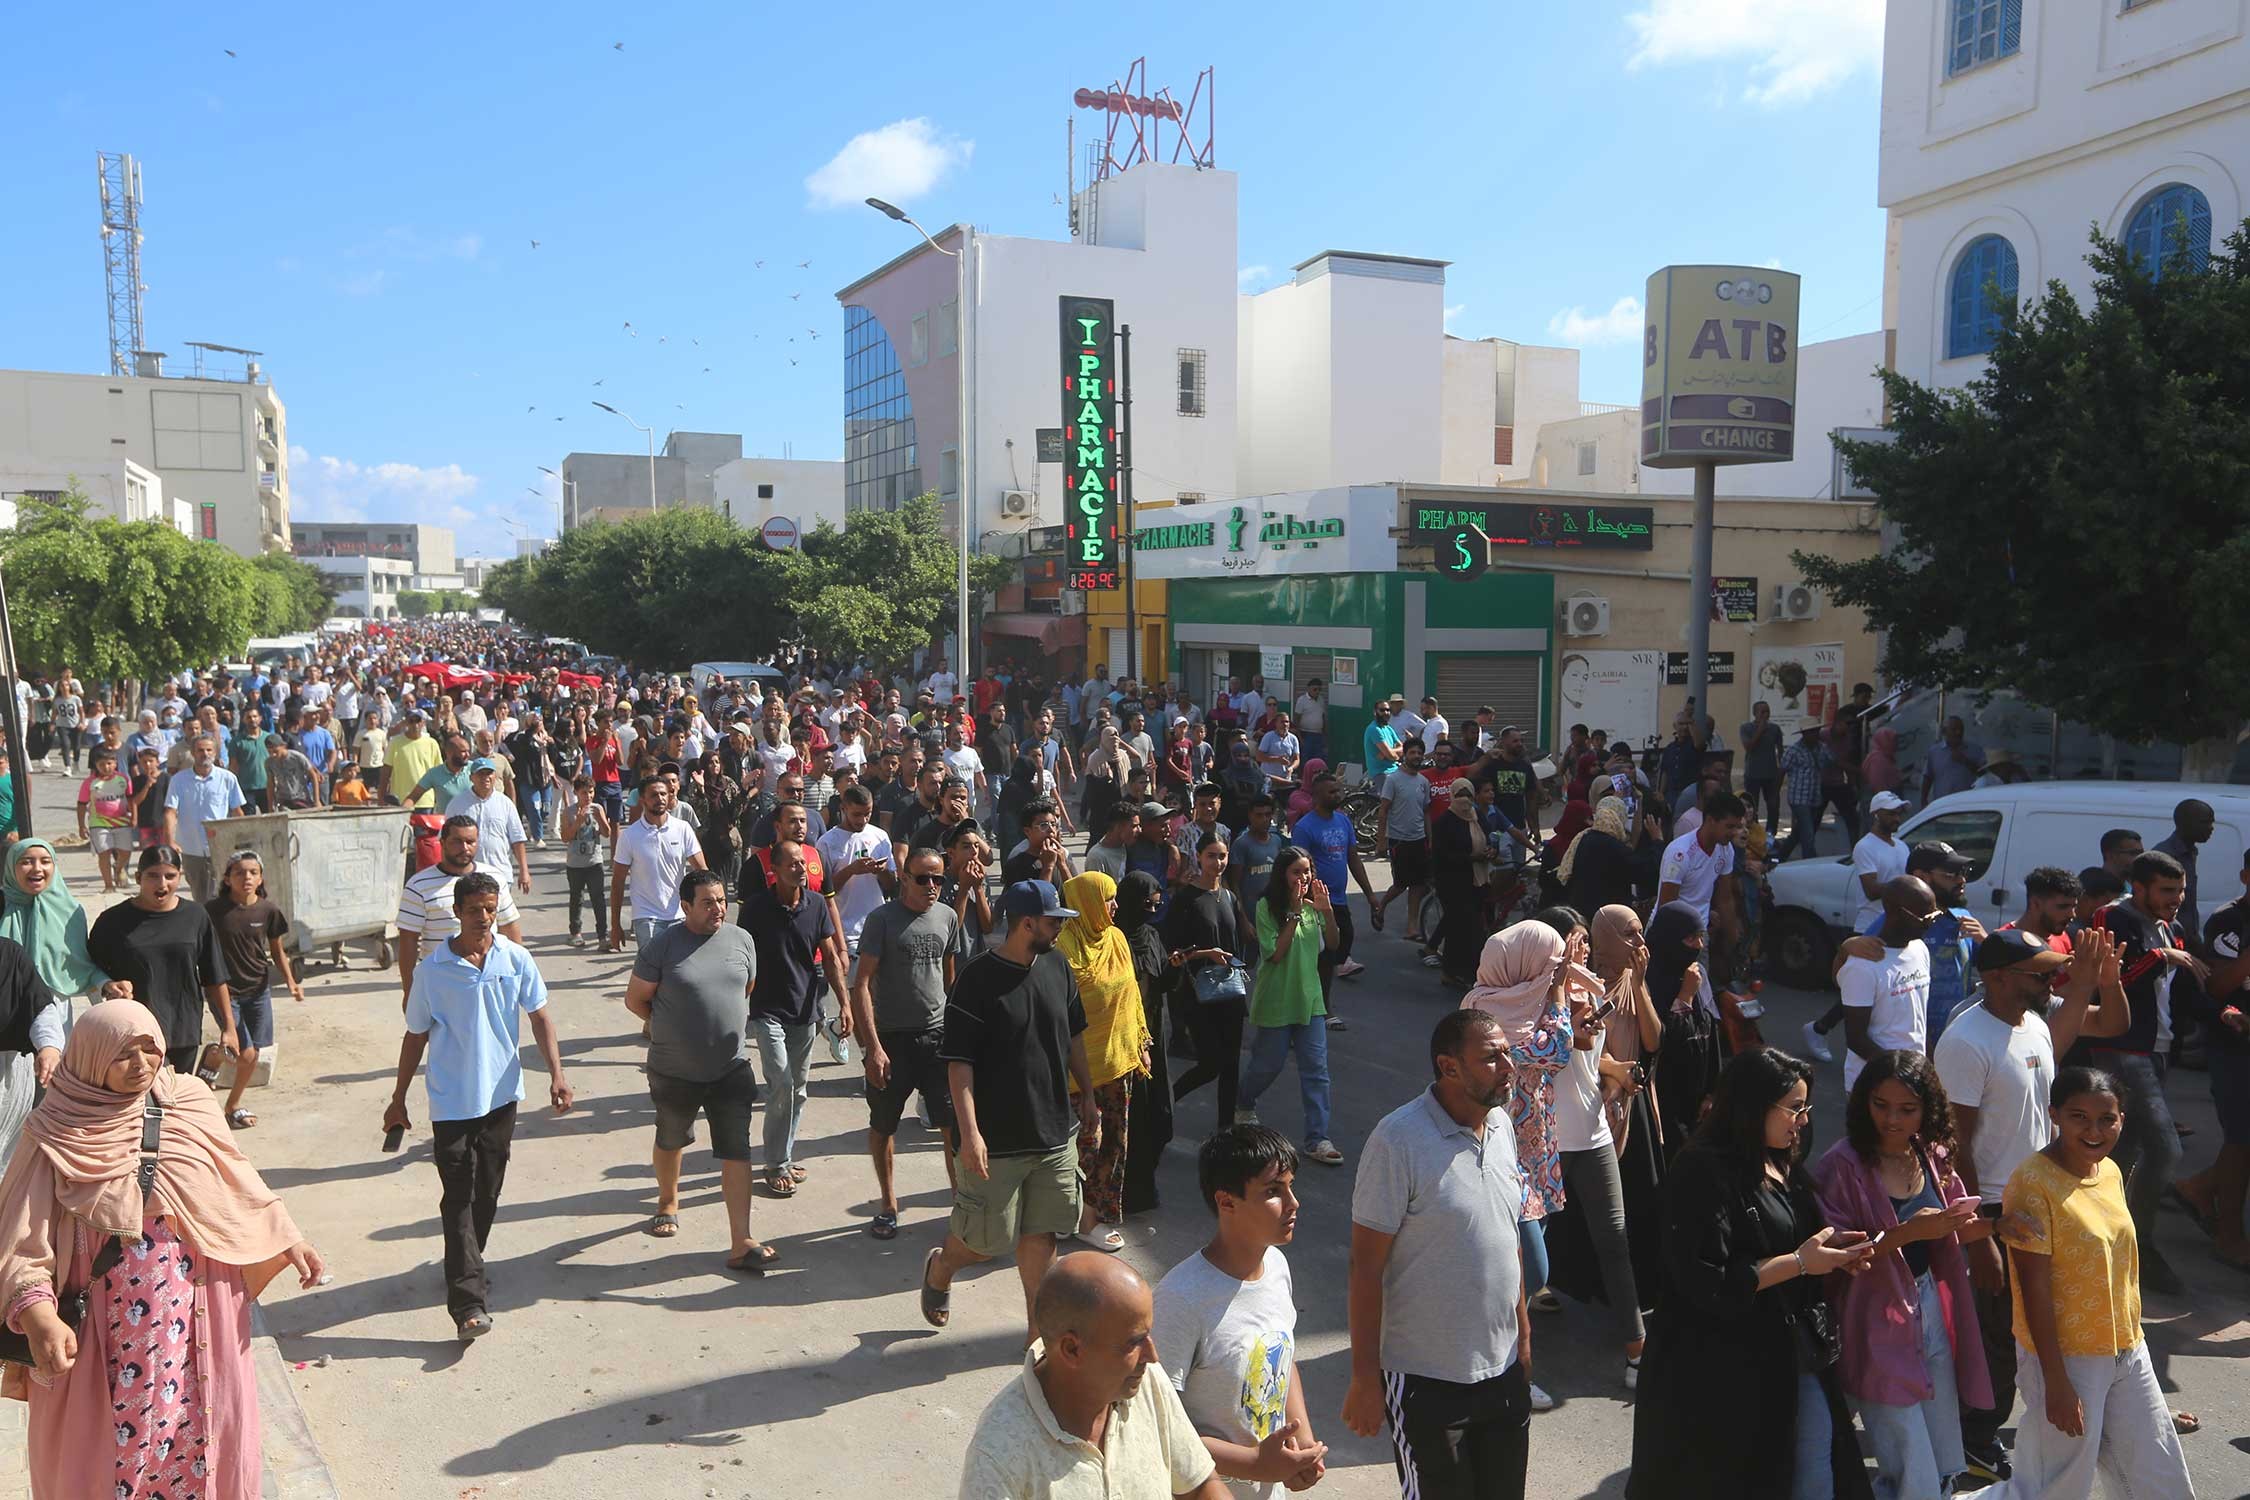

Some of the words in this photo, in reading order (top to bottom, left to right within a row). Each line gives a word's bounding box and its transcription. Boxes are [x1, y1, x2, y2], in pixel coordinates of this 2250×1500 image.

[1688, 318, 1787, 364] ATB
[1700, 427, 1776, 449] CHANGE
[1077, 354, 1105, 561] PHARMACIE
[1133, 521, 1215, 551] PHARMACIE
[1259, 511, 1345, 550] صيدلية
[1632, 653, 1653, 665] SVR
[1815, 650, 1836, 663] SVR
[1250, 864, 1273, 876] PUM
[912, 934, 932, 942] THE
